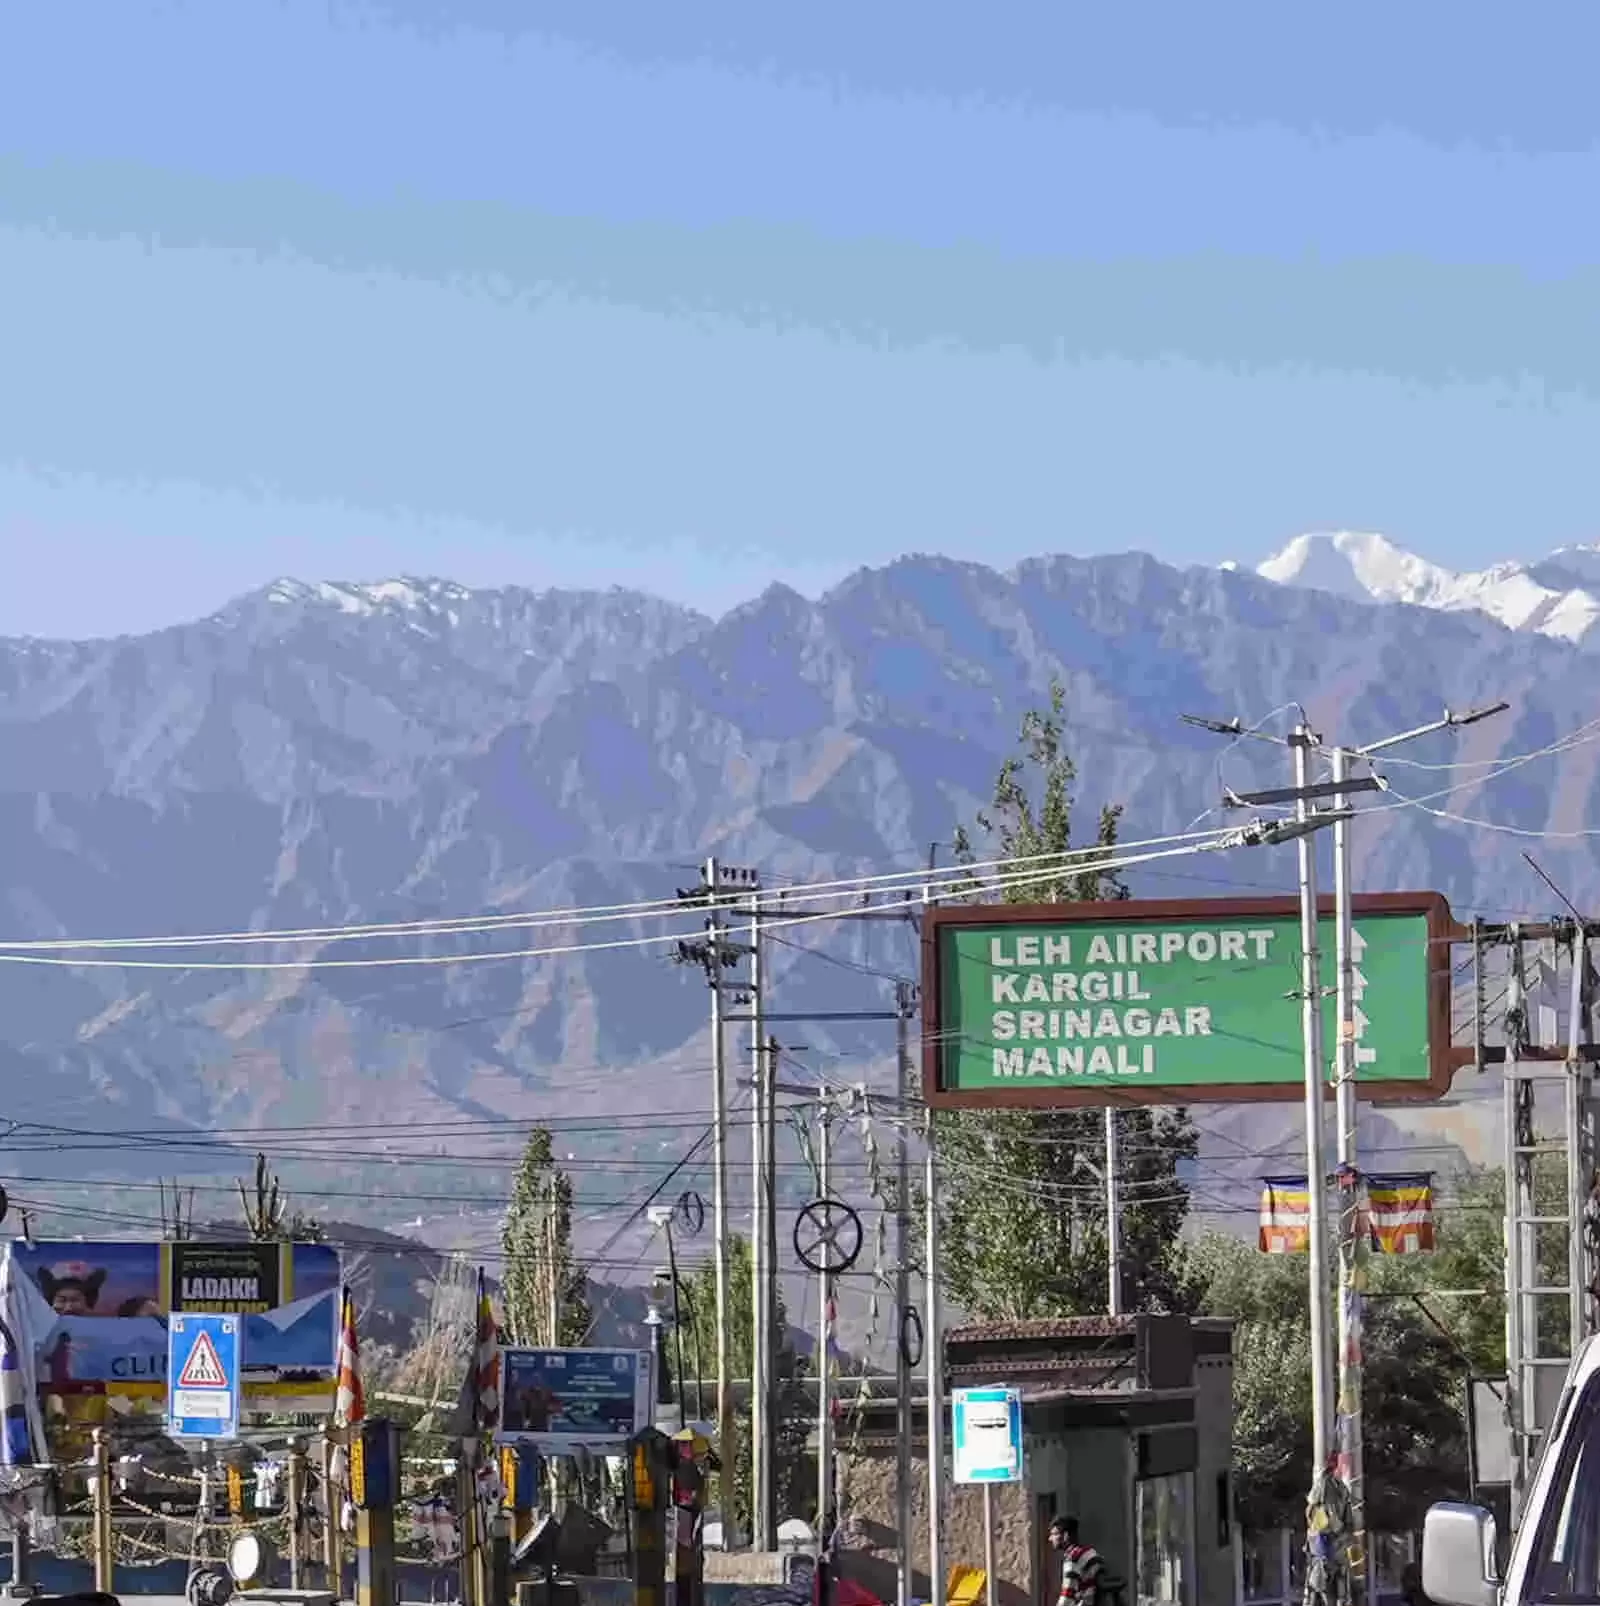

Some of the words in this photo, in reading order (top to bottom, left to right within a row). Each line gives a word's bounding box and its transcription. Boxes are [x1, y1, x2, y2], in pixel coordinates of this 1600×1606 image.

[991, 935, 1071, 966] LEH
[1085, 929, 1275, 965] AIRPORT
[992, 971, 1151, 1003] KARGIL
[992, 1006, 1214, 1040] SRINAGAR
[993, 1044, 1155, 1077] MANALI
[182, 1277, 260, 1300] LADAKH
